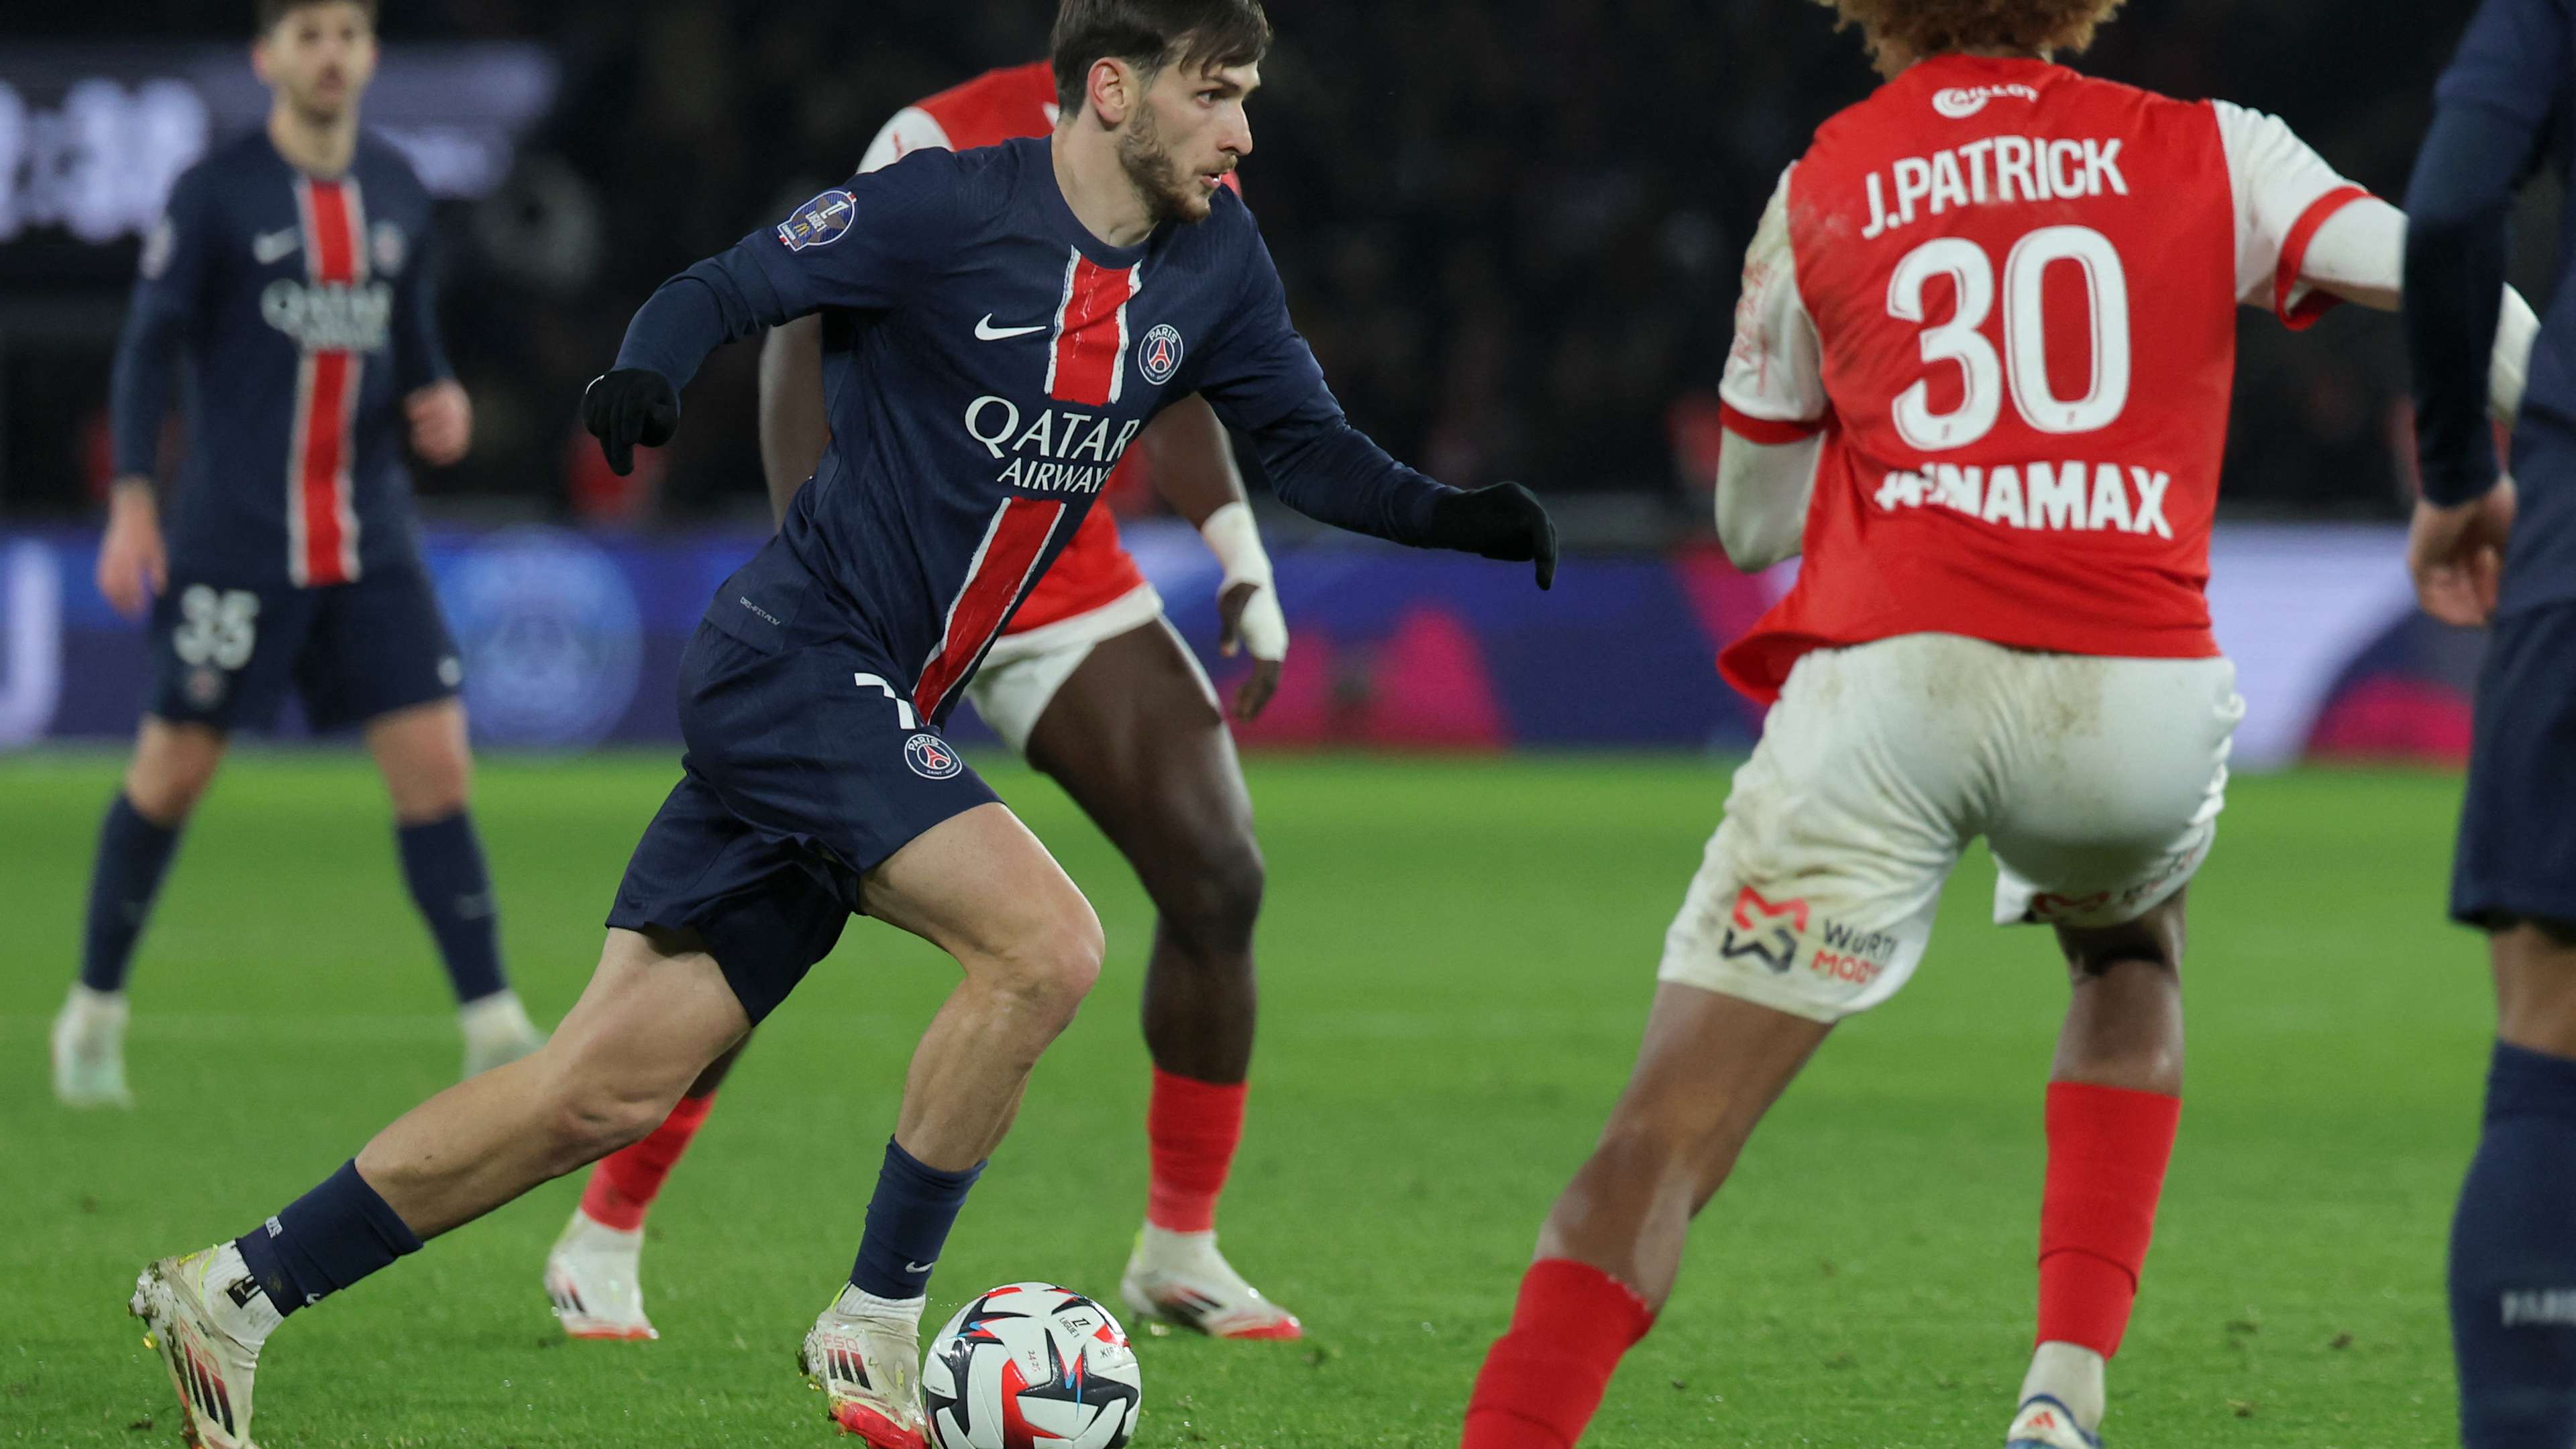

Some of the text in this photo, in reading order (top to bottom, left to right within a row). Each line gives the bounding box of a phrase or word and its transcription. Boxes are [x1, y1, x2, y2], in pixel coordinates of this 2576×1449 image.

[1862, 135, 2129, 239] J.PATRICK
[1148, 327, 1178, 344] PARIS
[1886, 225, 2131, 451] 30
[965, 395, 1140, 462] QATAR
[173, 584, 260, 670] 35
[908, 736, 939, 751] PARIS
